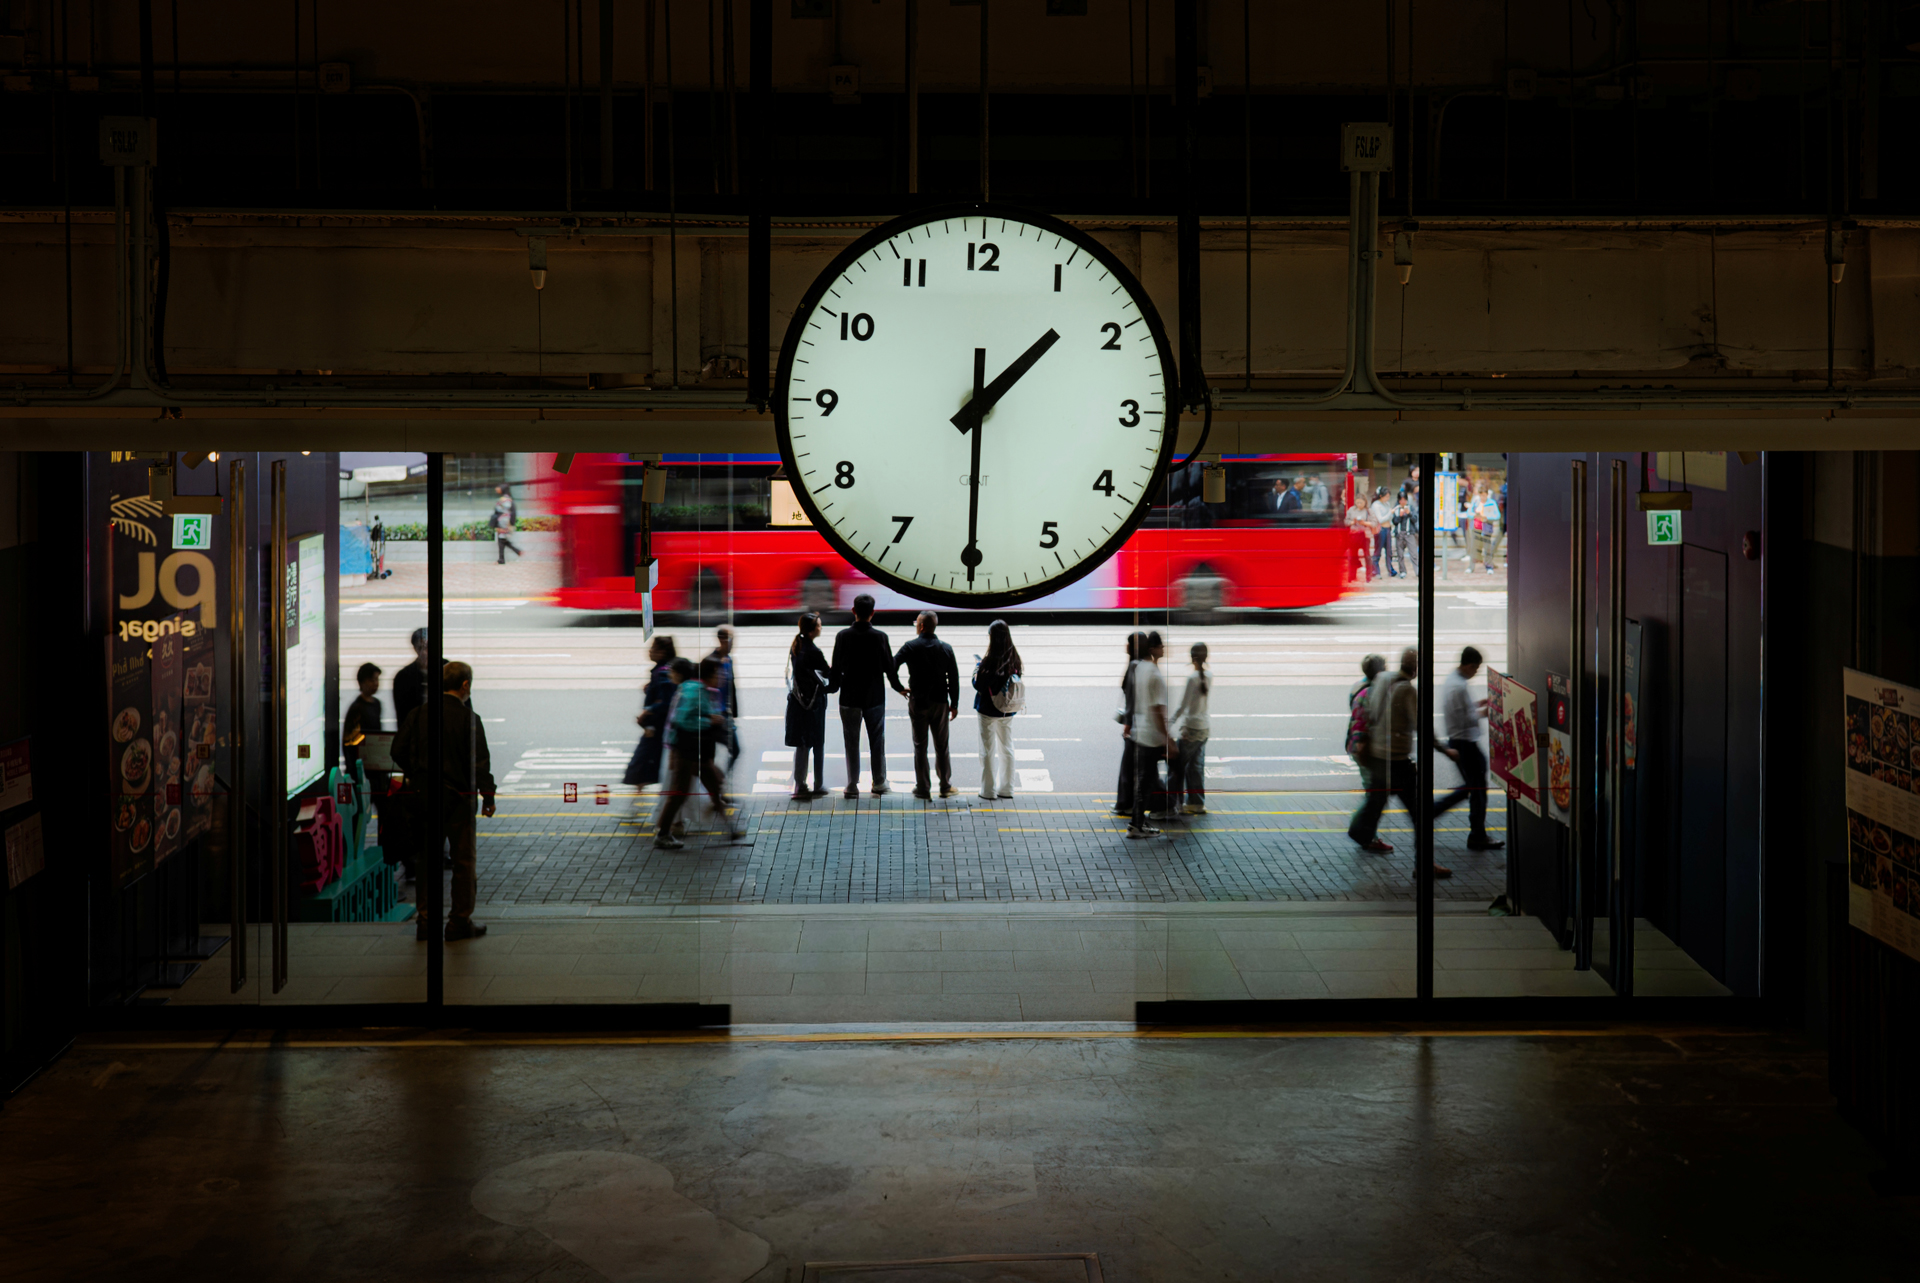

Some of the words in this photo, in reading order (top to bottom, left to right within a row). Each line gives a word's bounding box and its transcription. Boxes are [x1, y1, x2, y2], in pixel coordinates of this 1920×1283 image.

[835, 75, 852, 85] PA
[967, 243, 1000, 272] 12
[904, 258, 926, 287] 11
[1054, 264, 1062, 292] 1
[840, 312, 875, 341] 10
[1100, 322, 1122, 350] 2
[816, 389, 839, 417] 9
[1119, 400, 1141, 428] 3
[834, 461, 856, 489] 8
[959, 474, 990, 486] GNT
[1092, 470, 1116, 496] 4
[891, 516, 914, 543] 7
[1039, 521, 1060, 549] 5
